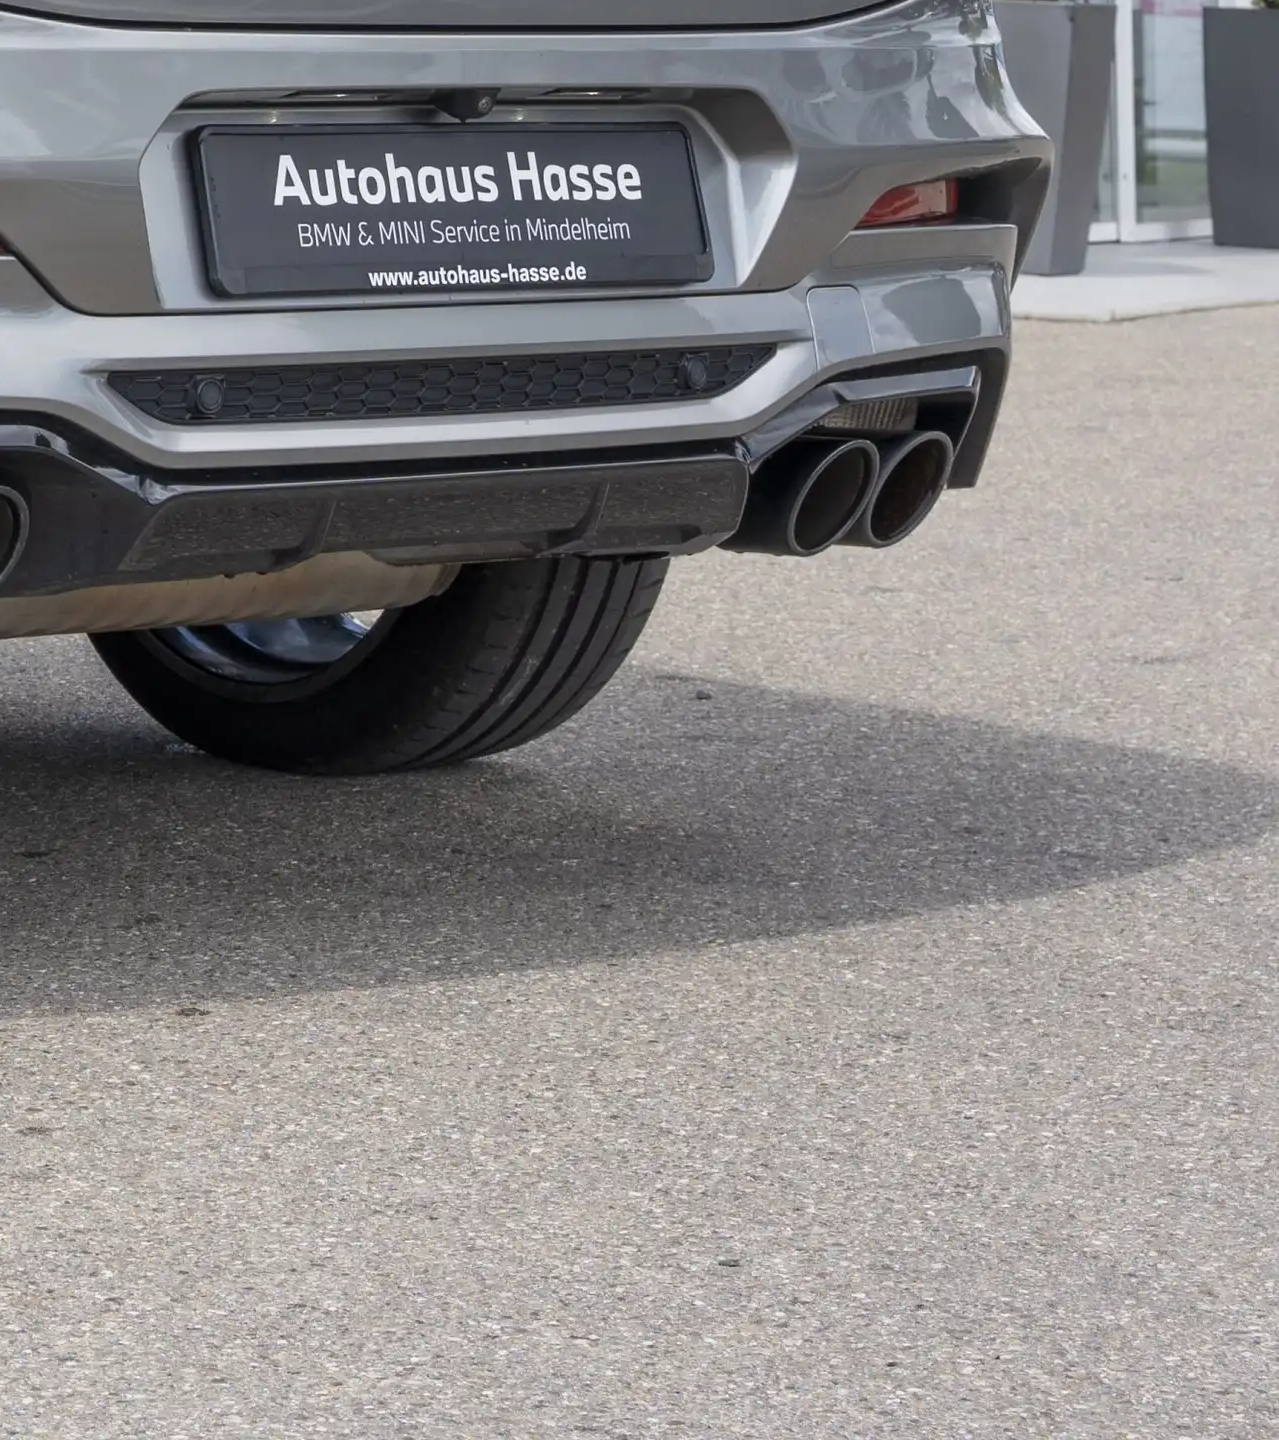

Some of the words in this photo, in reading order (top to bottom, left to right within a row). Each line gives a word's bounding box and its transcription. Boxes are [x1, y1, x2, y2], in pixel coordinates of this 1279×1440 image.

[274, 153, 499, 206] Autohaus
[507, 151, 642, 202] Hasse
[298, 222, 350, 248] BMW
[358, 221, 374, 246] &
[379, 220, 425, 245] MINI
[430, 219, 500, 244] Service
[504, 218, 522, 242] in
[526, 217, 631, 241] Mindelheim
[368, 261, 586, 287] www.autohaus-hasse.de
